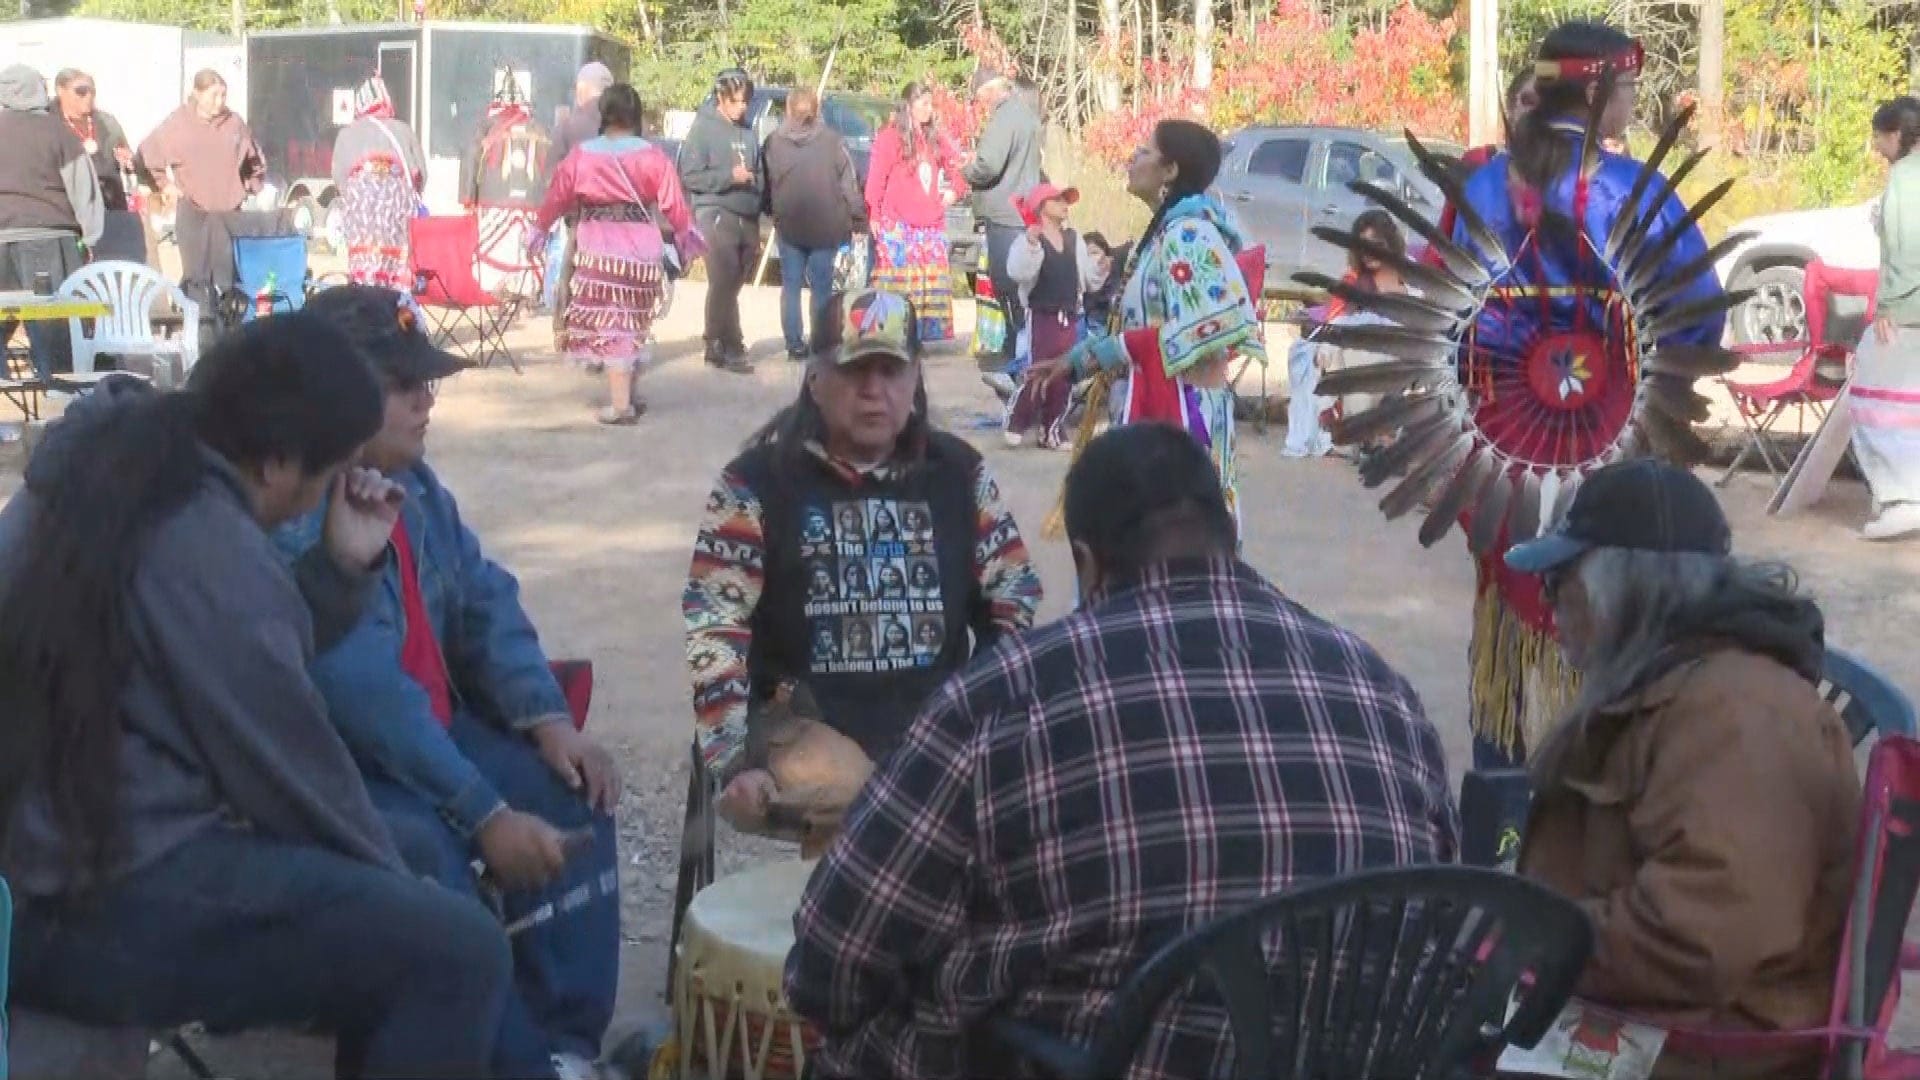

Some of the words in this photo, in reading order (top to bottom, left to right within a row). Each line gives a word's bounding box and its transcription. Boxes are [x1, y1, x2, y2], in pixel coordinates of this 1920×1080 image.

[836, 541, 864, 555] The
[804, 601, 858, 616] doesn't
[859, 600, 908, 614] belong
[910, 600, 924, 612] to
[926, 600, 944, 612] us
[828, 659, 873, 673] belong
[875, 659, 888, 671] to
